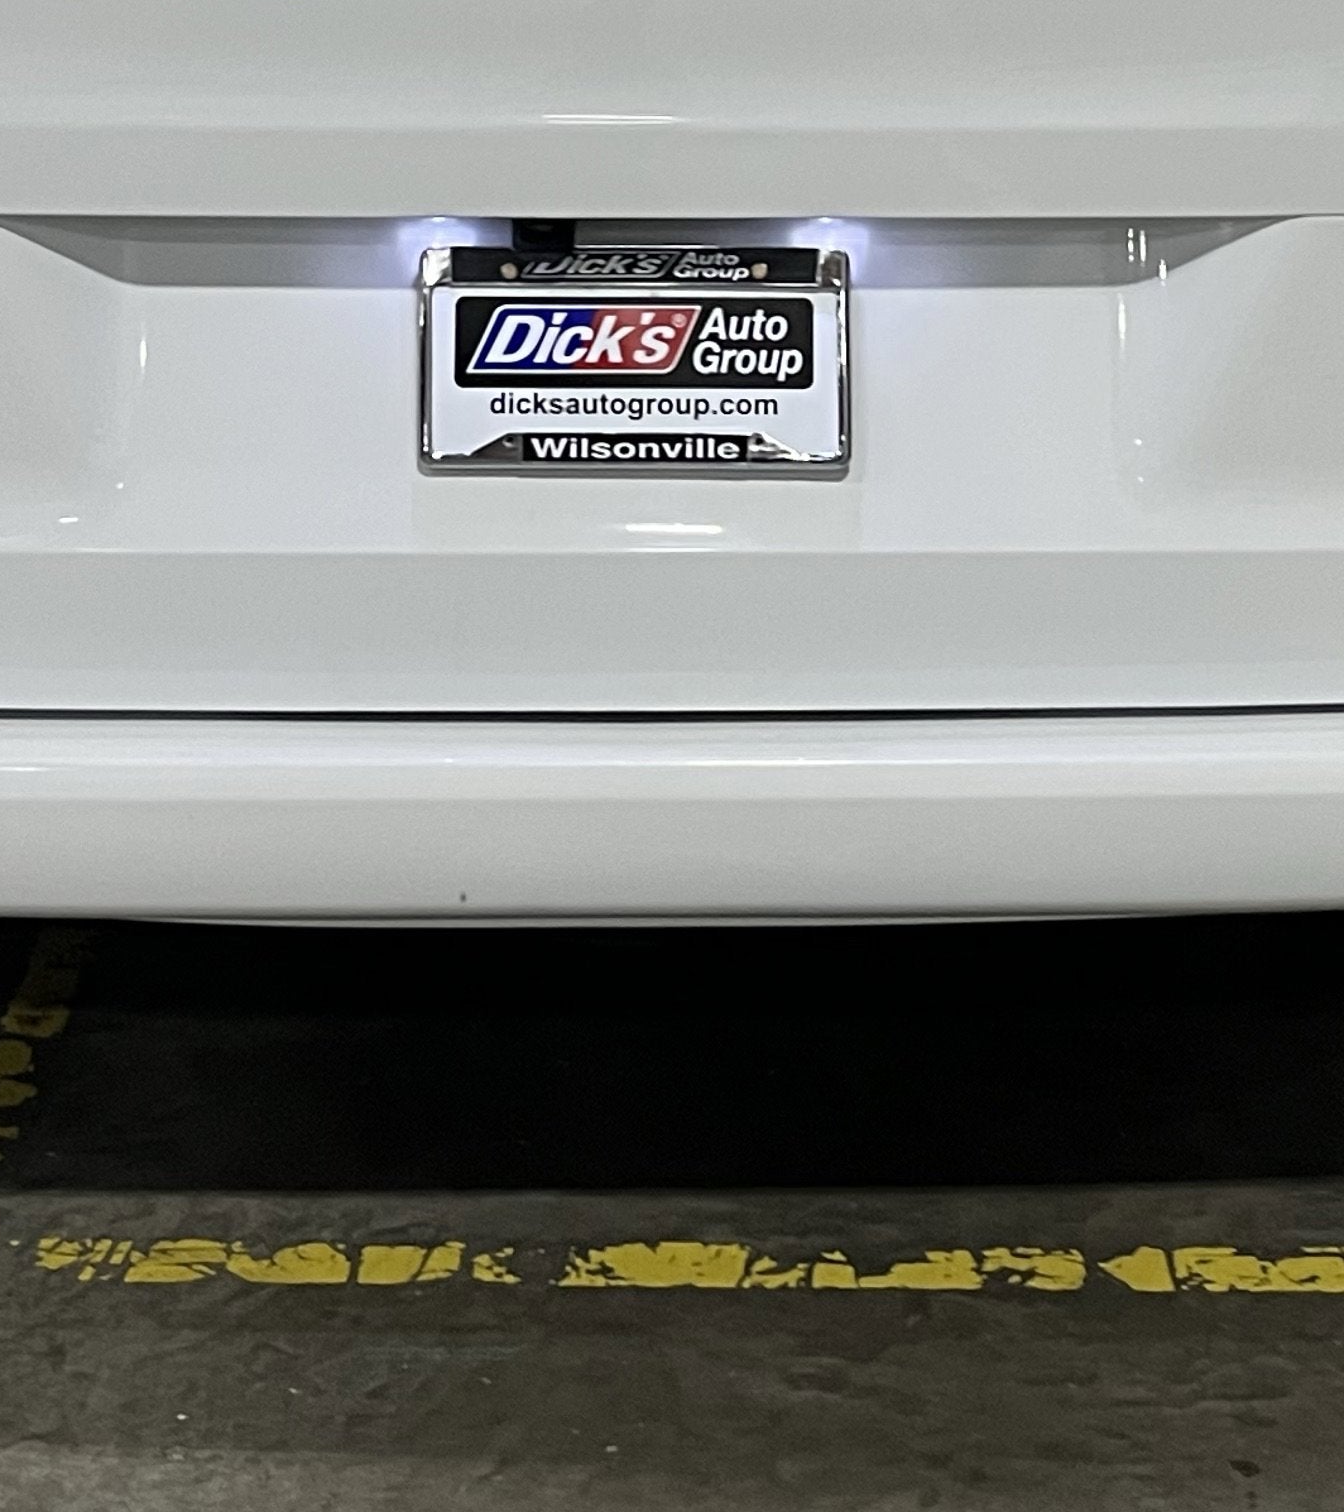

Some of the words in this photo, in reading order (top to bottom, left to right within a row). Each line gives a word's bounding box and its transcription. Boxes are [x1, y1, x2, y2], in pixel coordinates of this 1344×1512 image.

[672, 264, 750, 281] Group
[678, 251, 740, 266] Auto
[485, 311, 675, 364] Dick's
[698, 307, 789, 342] Auto
[692, 342, 804, 382] Group
[489, 392, 779, 420] dicksautogroup.com
[530, 437, 741, 460] Wilsonville
